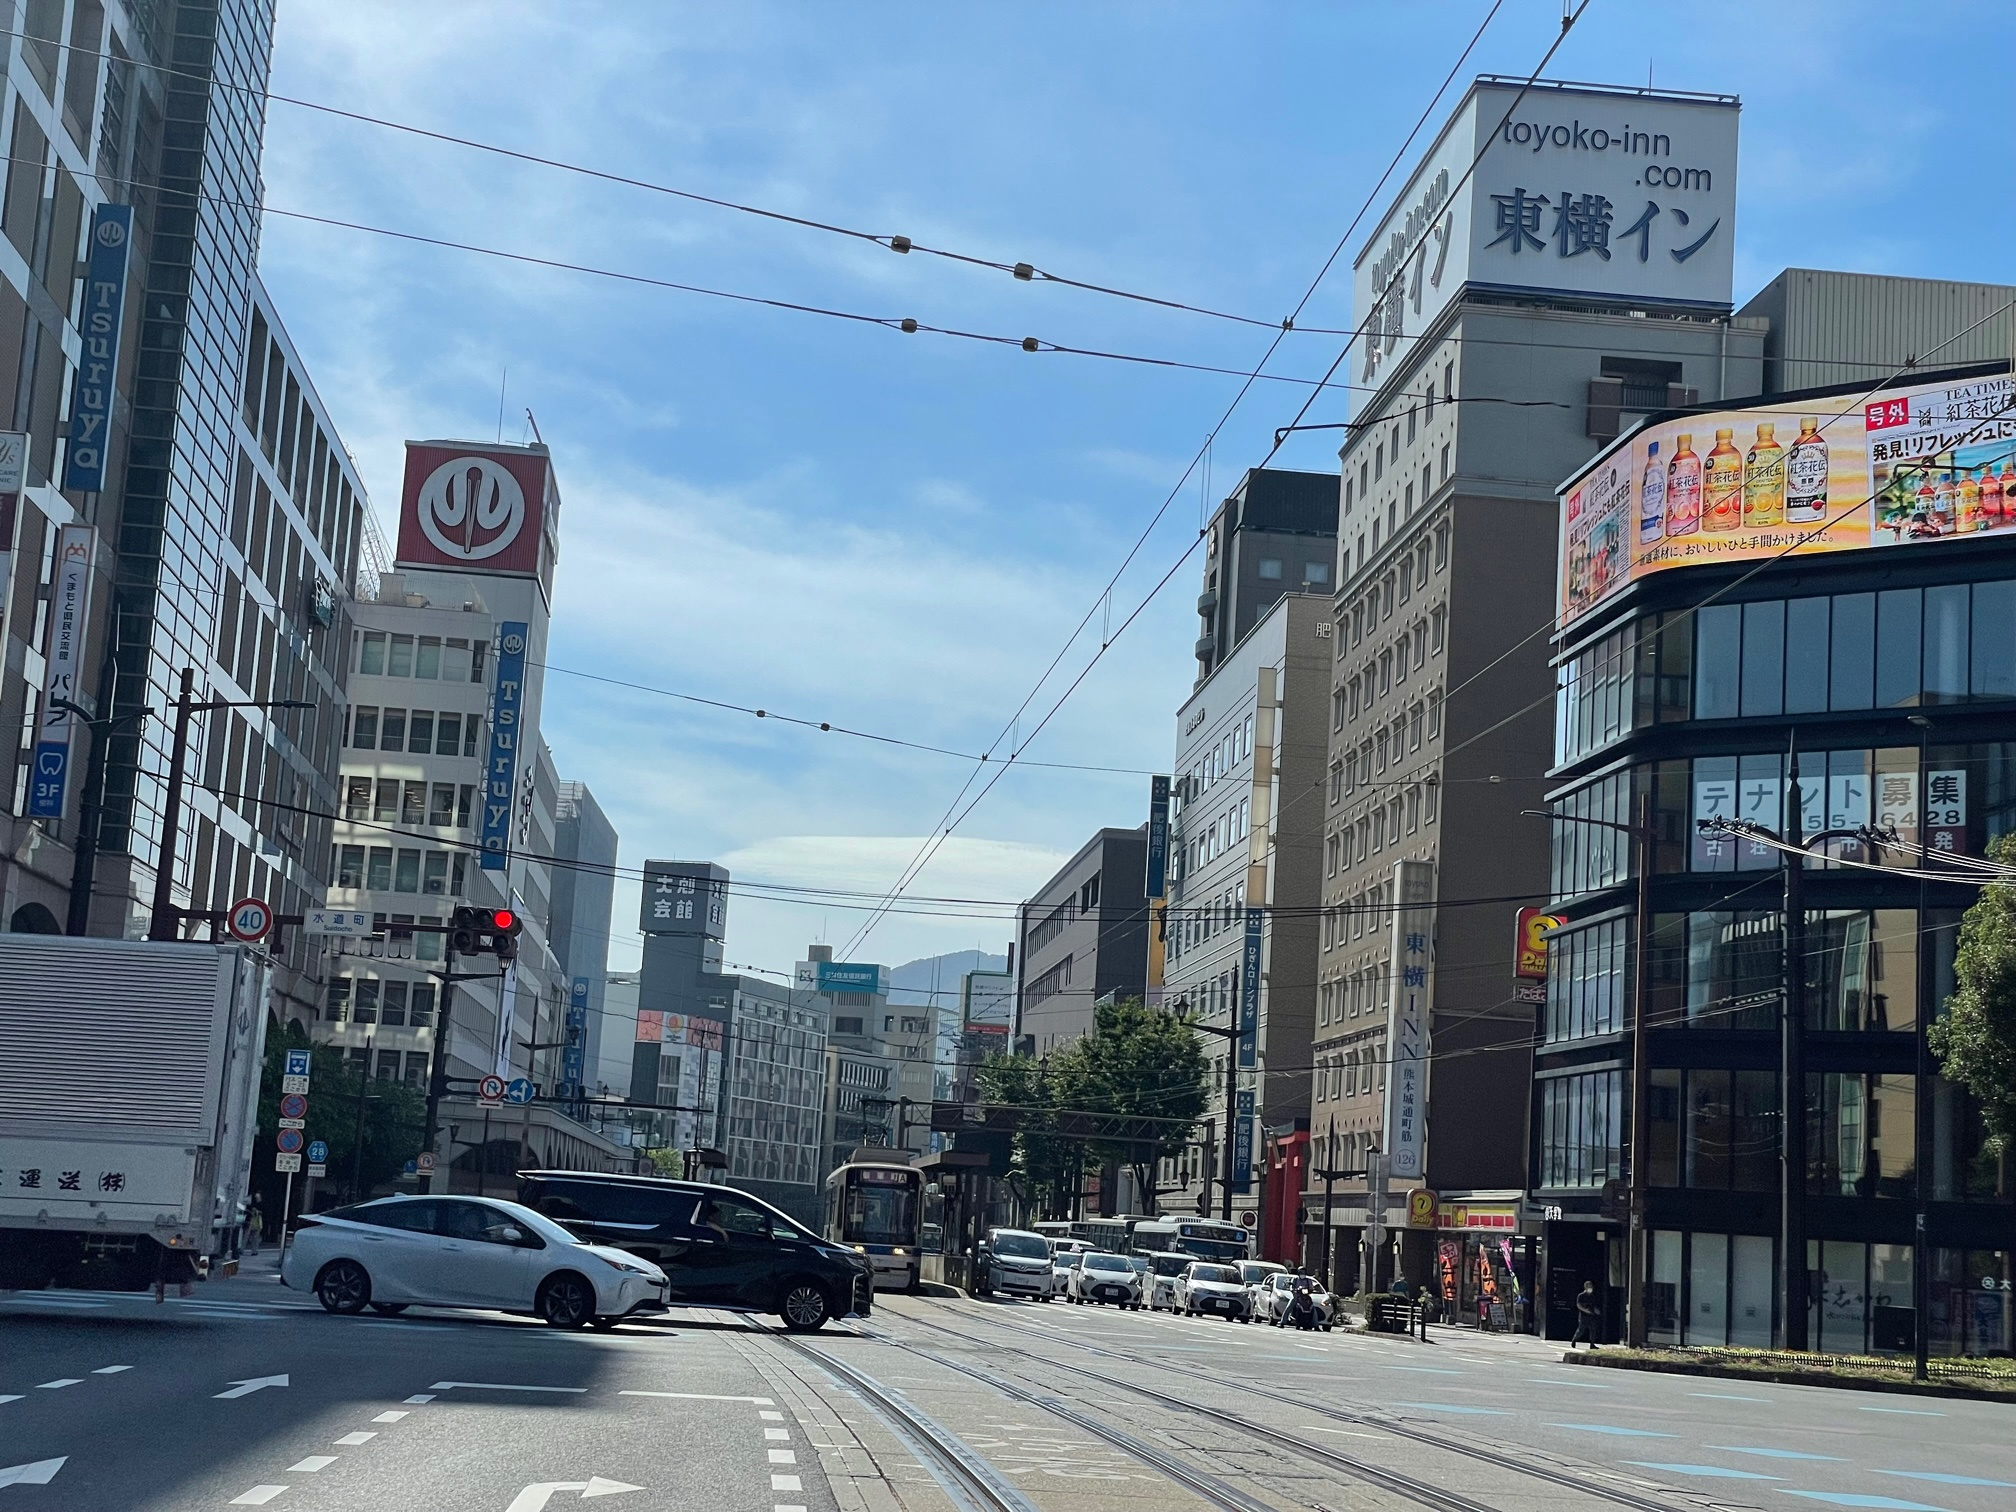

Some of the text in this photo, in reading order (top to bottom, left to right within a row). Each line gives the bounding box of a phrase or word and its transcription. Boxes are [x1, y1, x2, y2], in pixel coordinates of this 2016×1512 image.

[1503, 119, 1671, 157] toyoko-inn
[1635, 164, 1712, 192] .com
[1484, 187, 1721, 264] 東横イン
[73, 281, 117, 470] Tsuruya
[1869, 402, 1905, 426] 号外
[1791, 459, 1827, 475] 紅茶花伝
[486, 680, 518, 852] Tsuruya
[37, 783, 60, 797] 3F
[1151, 812, 1165, 859] 肥後銀行
[238, 910, 262, 930] 40
[313, 913, 365, 926] 水道町
[654, 899, 694, 919] 会館
[323, 925, 353, 933] Suidocho
[1242, 1043, 1253, 1051] 4F
[1401, 1068, 1415, 1142] 熊本城通町筋
[311, 1147, 325, 1156] 28
[1237, 1123, 1250, 1170] 肥後銀行
[1397, 1153, 1416, 1166] 126
